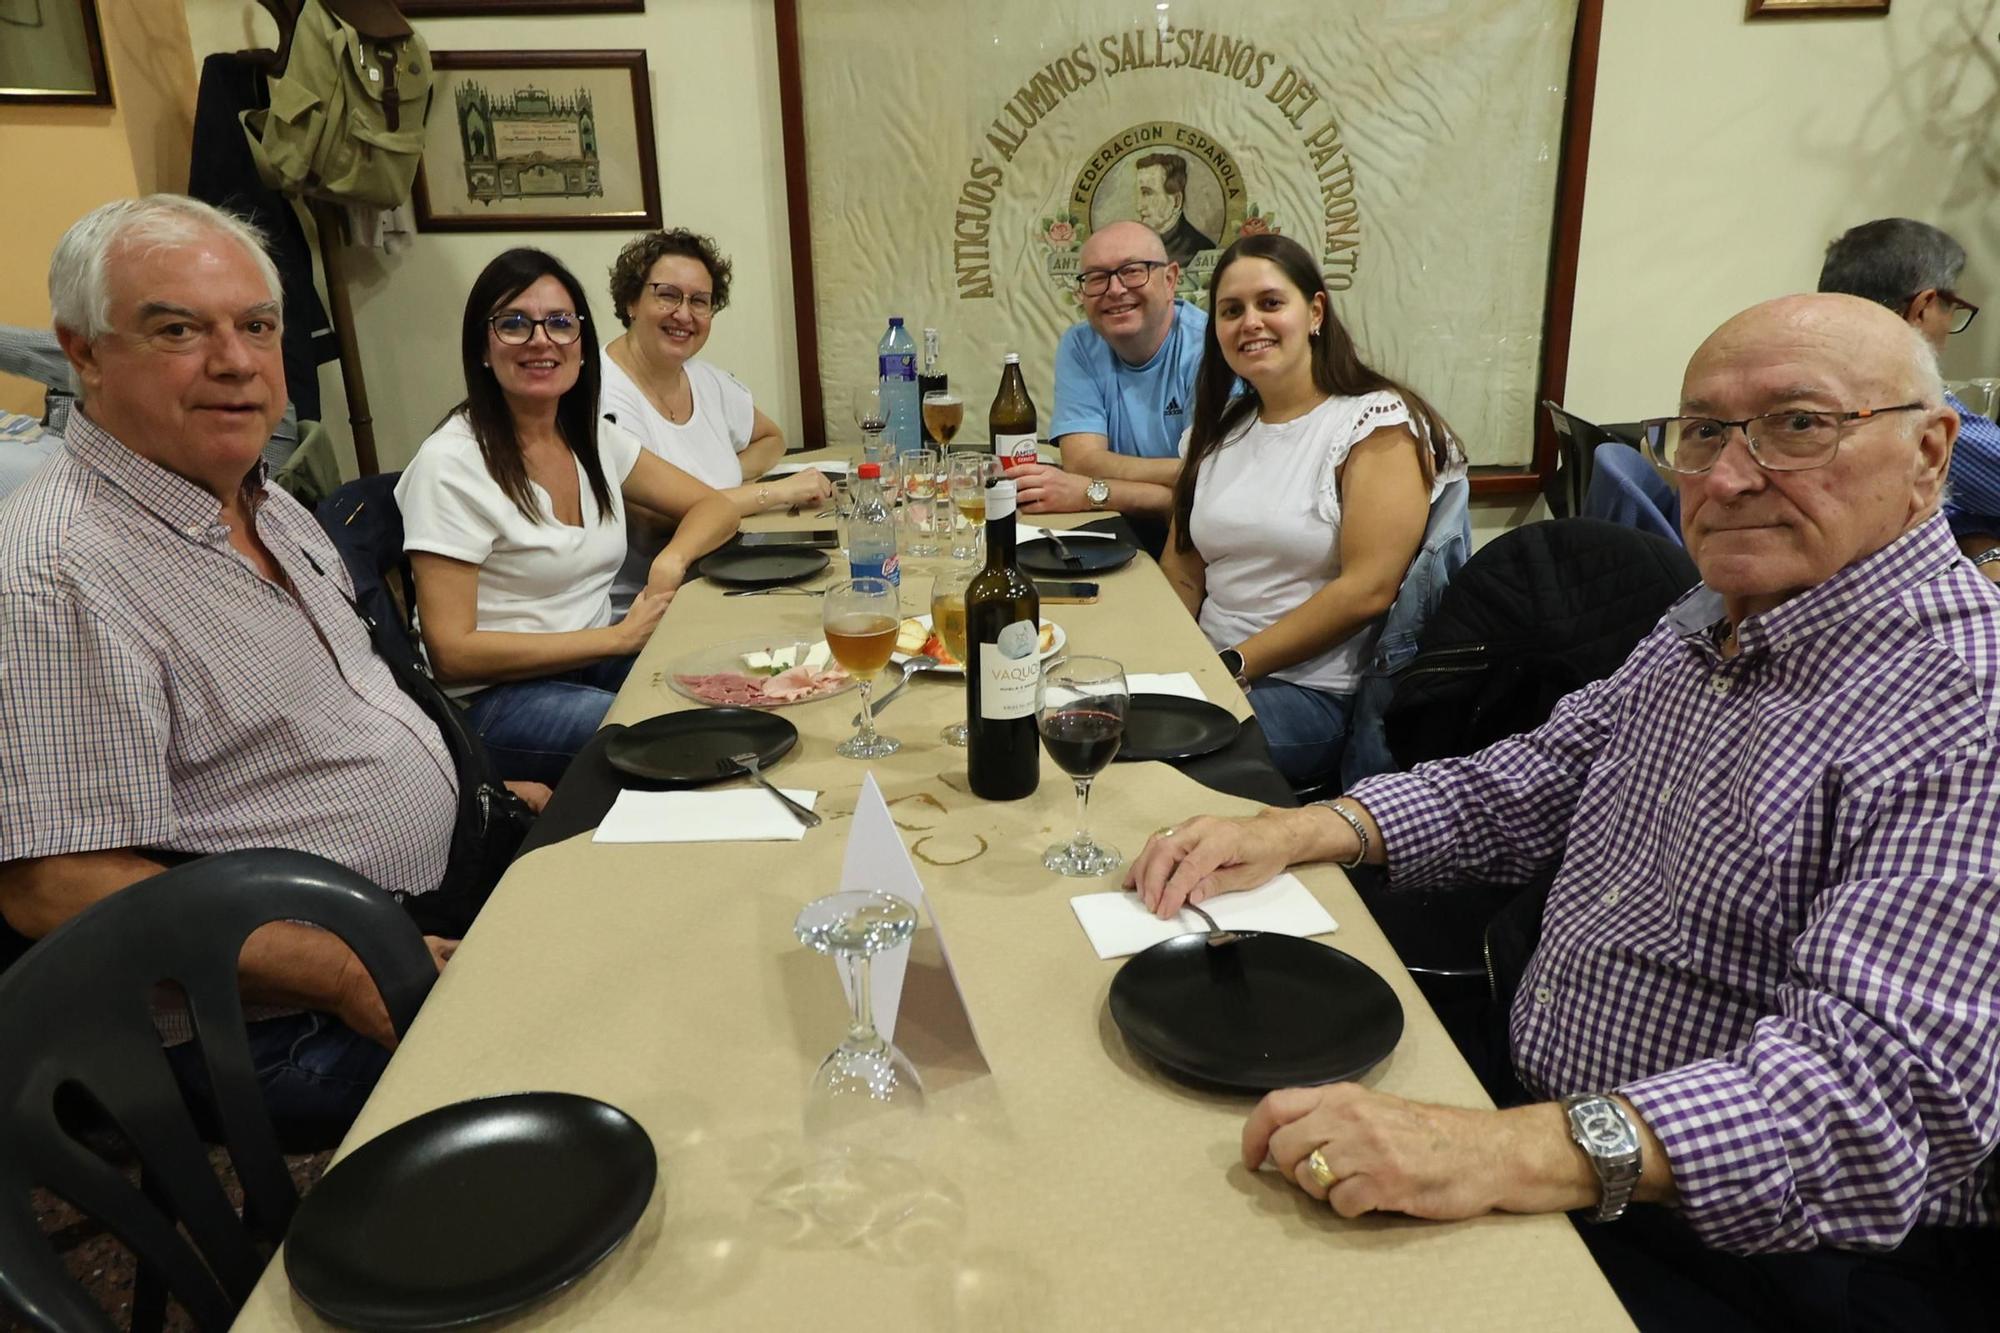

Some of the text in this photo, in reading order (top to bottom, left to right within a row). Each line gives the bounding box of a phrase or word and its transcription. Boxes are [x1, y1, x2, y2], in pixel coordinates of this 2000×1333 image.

[954, 26, 1360, 299] ANTIGUOS ALUMNOS SALESIANOS DEL PATRONATO
[1075, 126, 1240, 204] FEDERACION ESPAÑOLA
